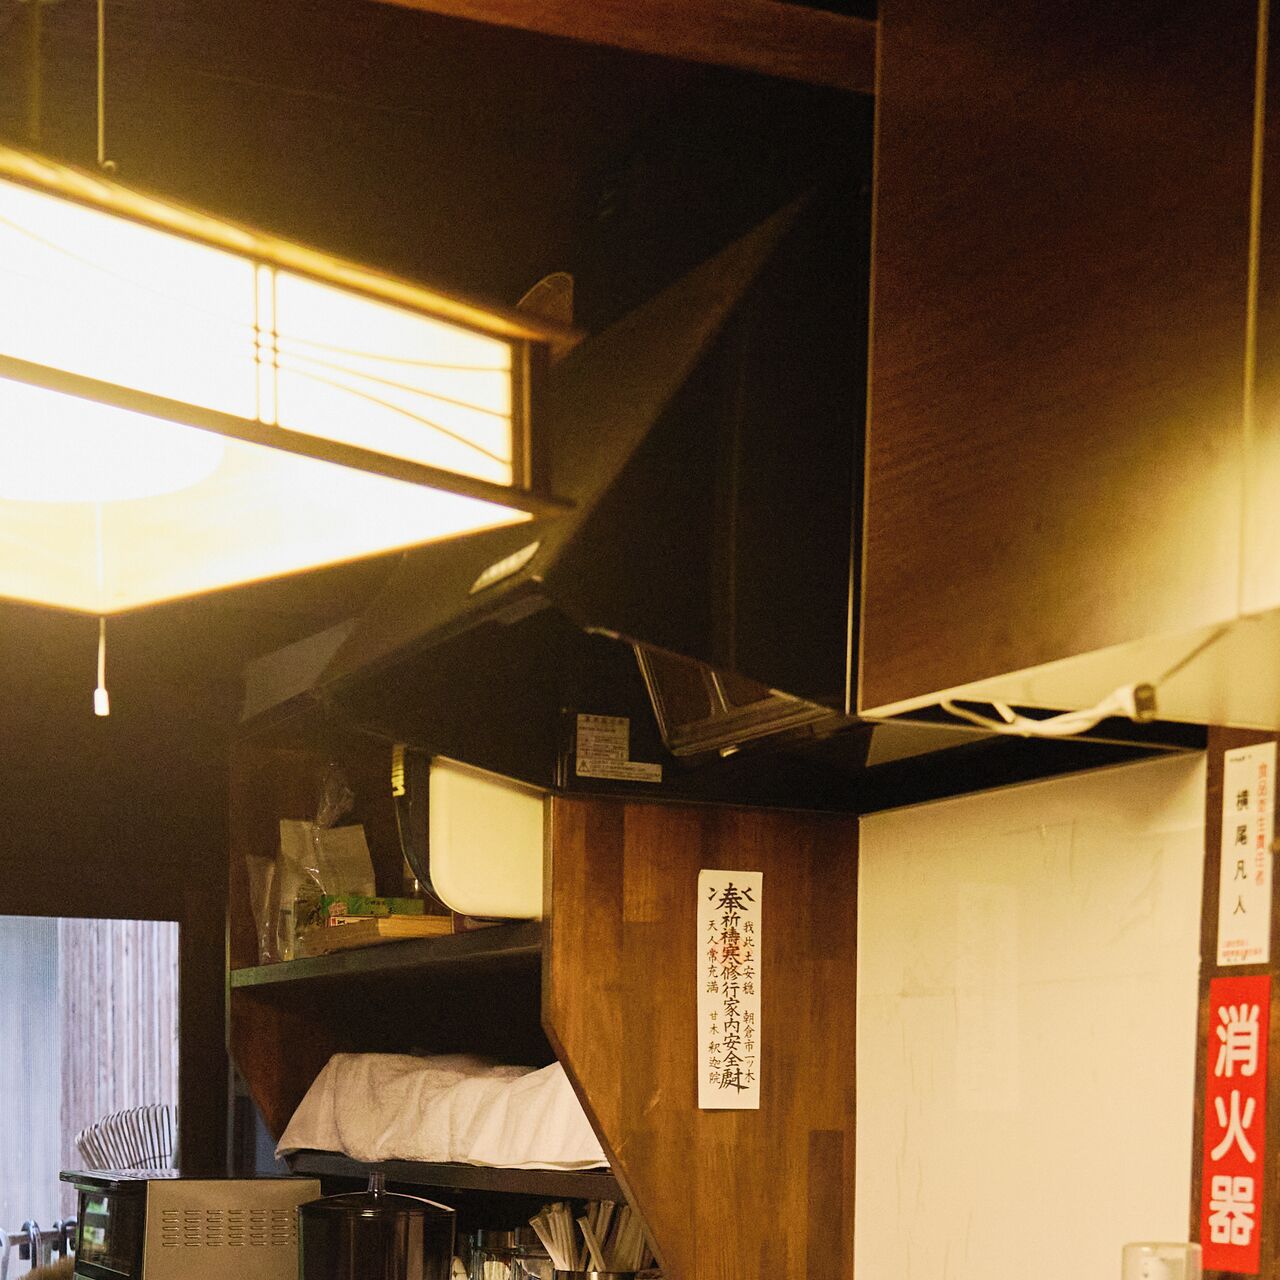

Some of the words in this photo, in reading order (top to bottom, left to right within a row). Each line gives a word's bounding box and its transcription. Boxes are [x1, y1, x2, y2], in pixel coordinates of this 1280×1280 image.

[1233, 789, 1249, 915] 横尾凡人
[1208, 1004, 1260, 1247] 消火器
